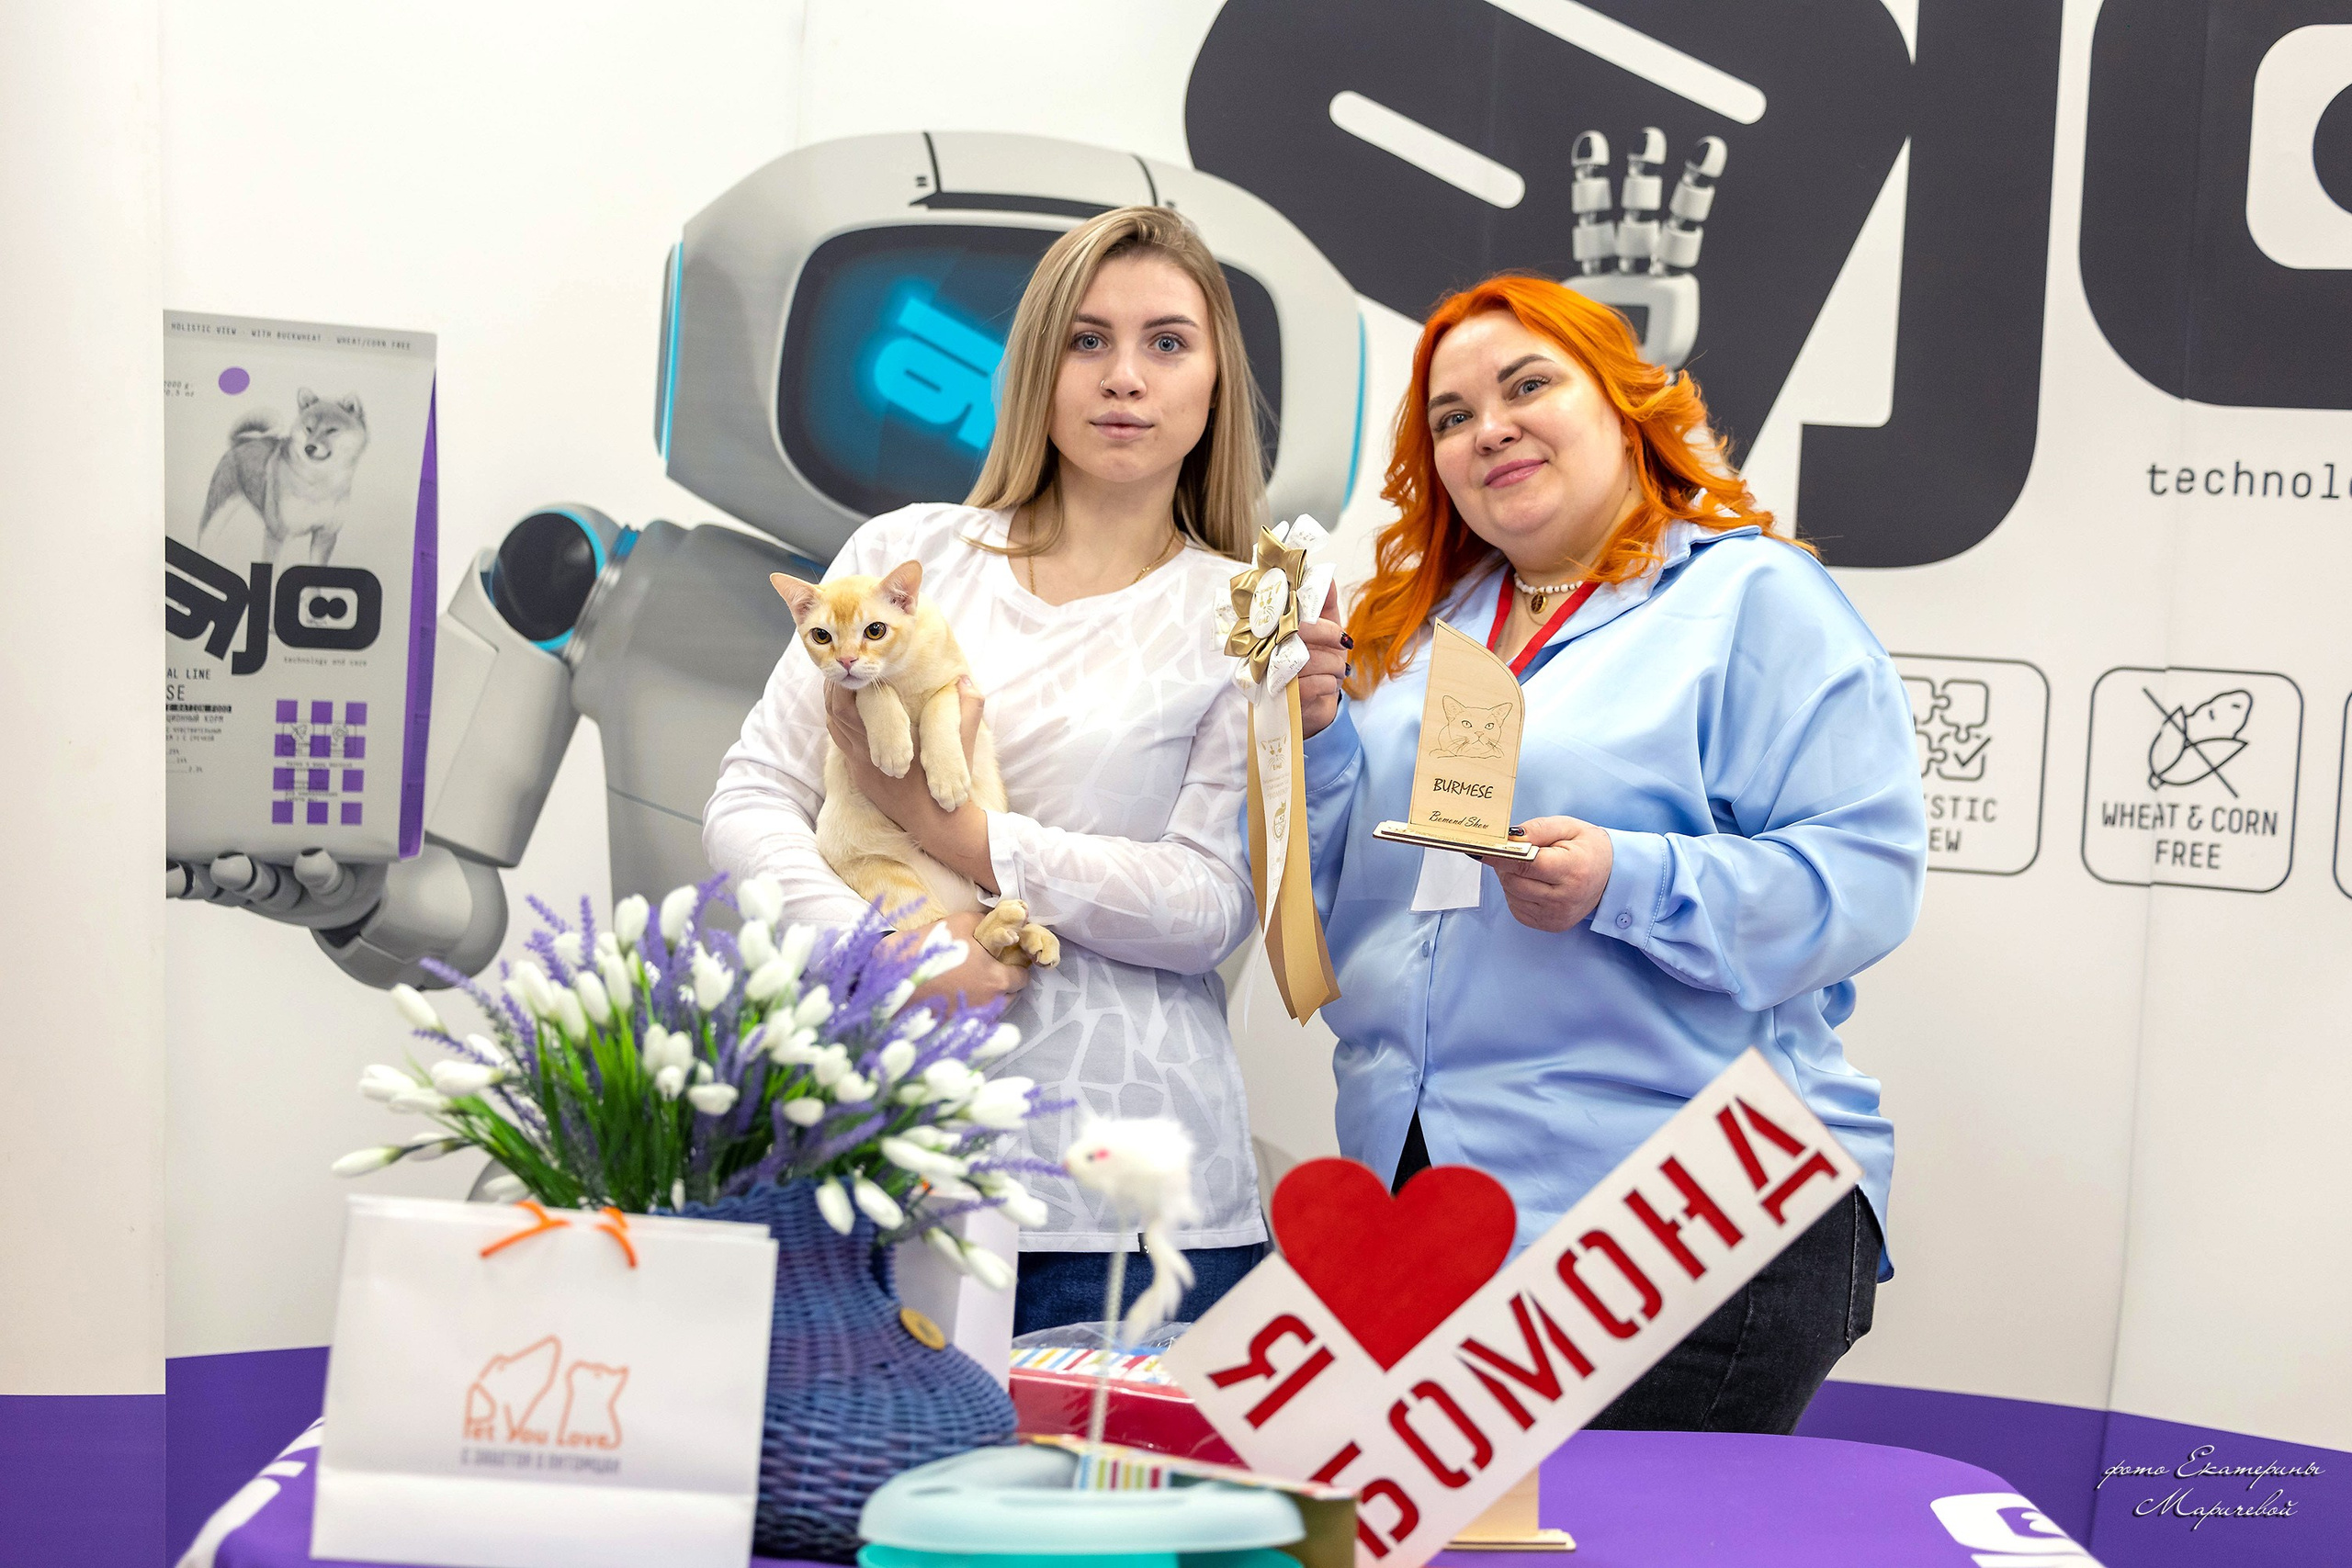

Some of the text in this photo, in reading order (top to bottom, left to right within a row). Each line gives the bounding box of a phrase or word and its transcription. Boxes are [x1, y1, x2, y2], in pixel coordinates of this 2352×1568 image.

[216, 327, 238, 336] VIEW
[2146, 460, 2352, 499] technol
[186, 668, 210, 681] LINE
[1432, 777, 1494, 799] BURMESE
[1925, 794, 1998, 822] STIC
[2102, 801, 2278, 836] WHEAT & CORN
[2154, 839, 2222, 870] FREE
[1309, 1095, 1840, 1562] БОМОНД
[1206, 1314, 1337, 1430] Я
